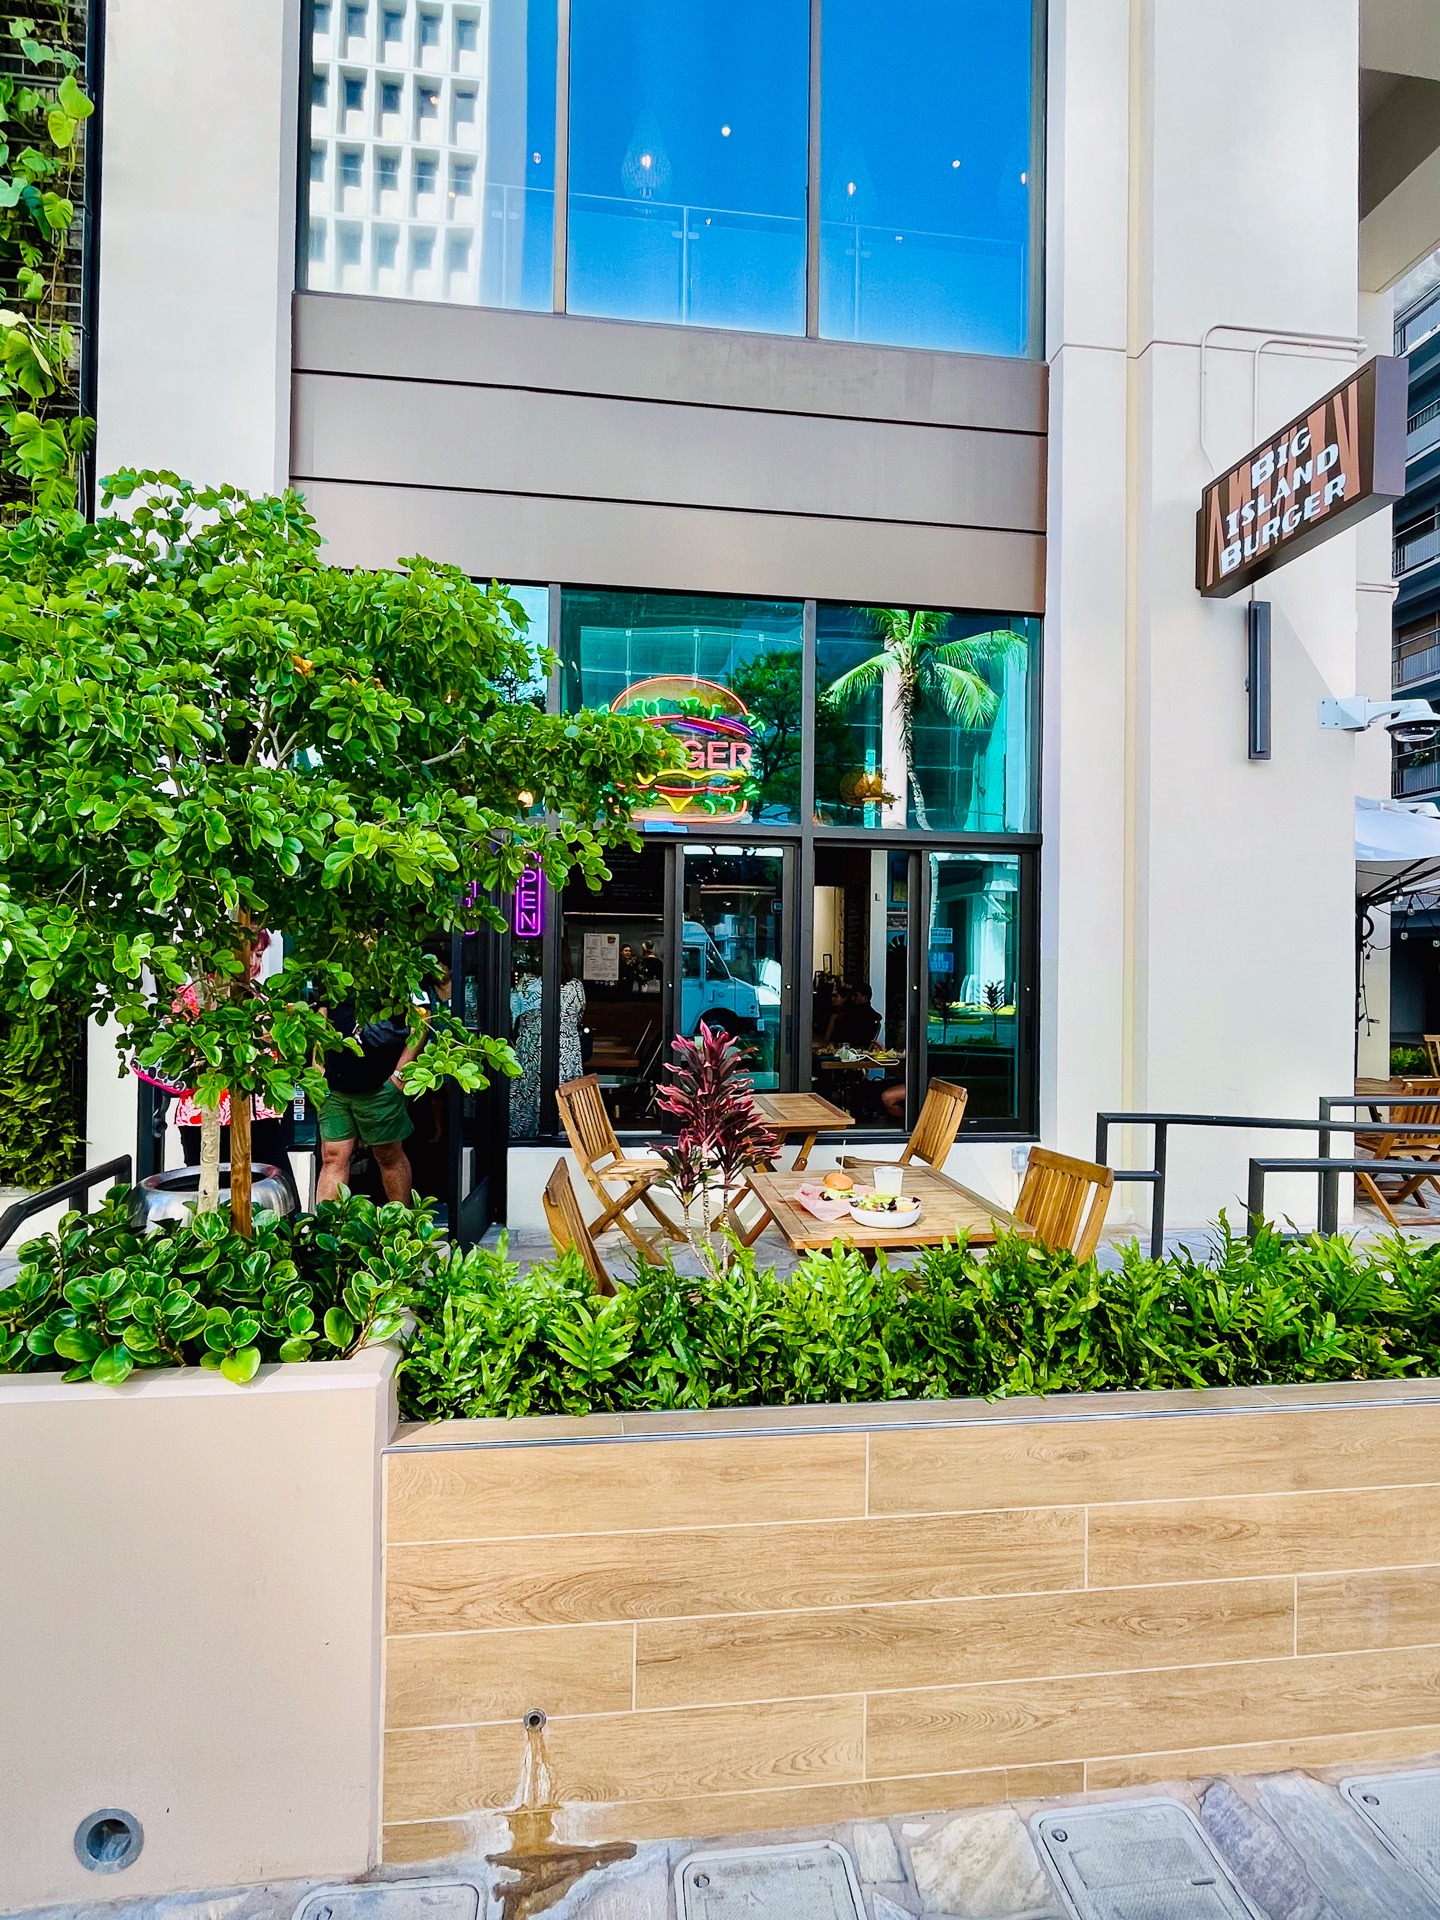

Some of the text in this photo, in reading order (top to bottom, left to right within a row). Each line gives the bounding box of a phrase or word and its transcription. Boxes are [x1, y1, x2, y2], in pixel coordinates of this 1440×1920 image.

[1226, 443, 1338, 539] ISLAND
[1251, 427, 1311, 489] BIG
[1220, 473, 1347, 575] BURGER
[682, 740, 753, 770] GER
